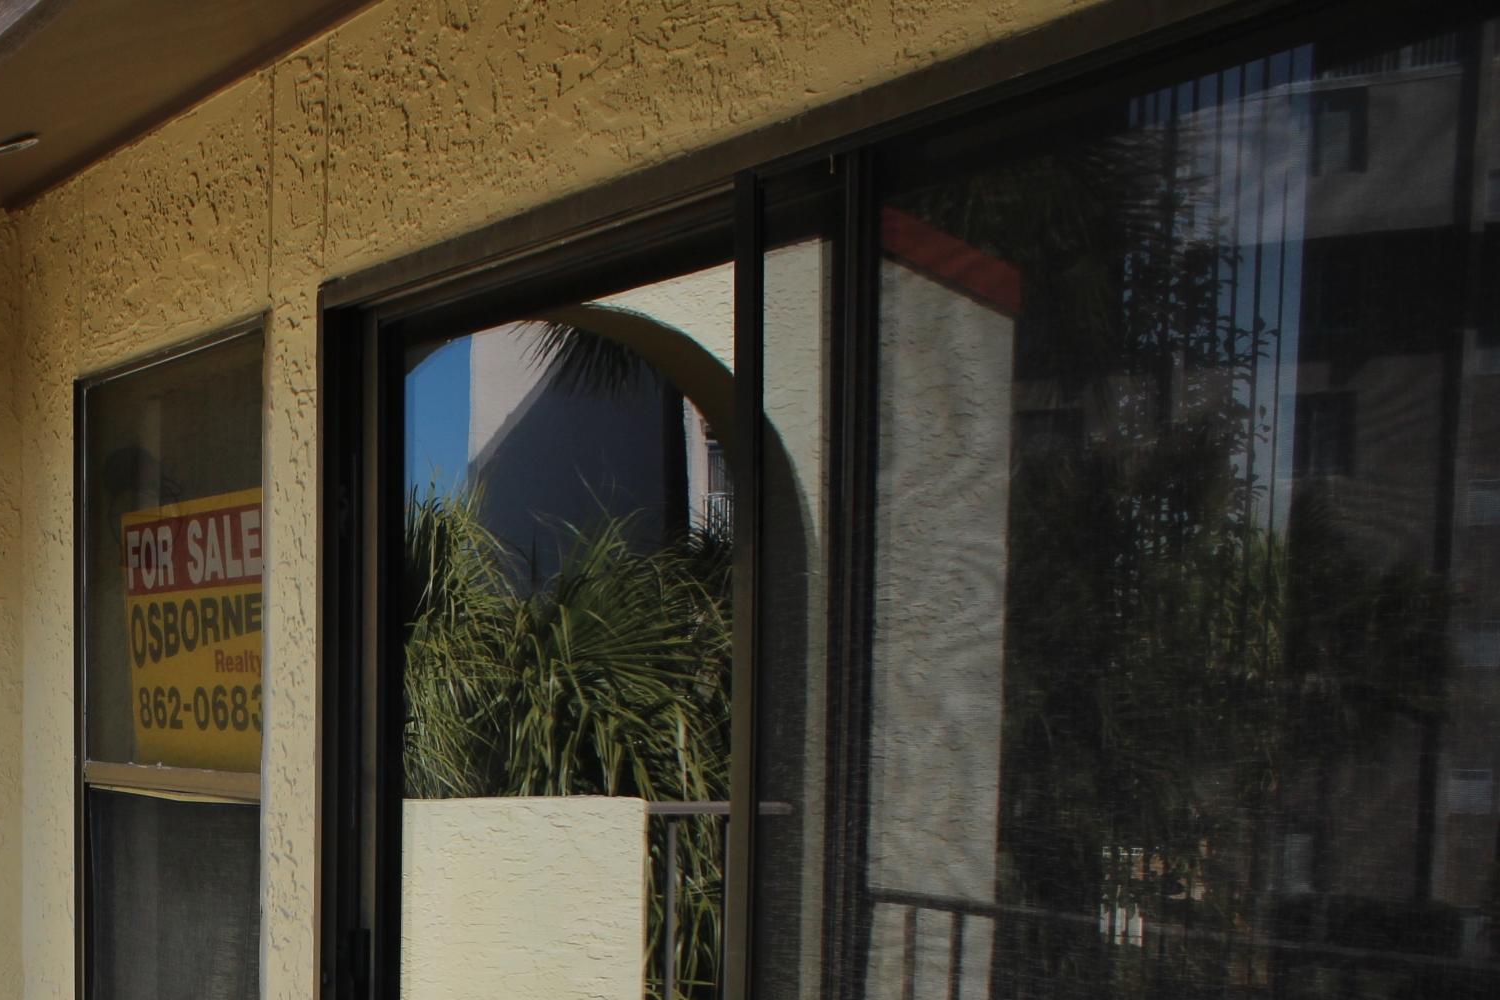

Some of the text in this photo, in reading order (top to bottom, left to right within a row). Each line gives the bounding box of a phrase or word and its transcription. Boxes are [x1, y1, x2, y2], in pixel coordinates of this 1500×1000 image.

[128, 510, 262, 589] FOR SALE
[131, 592, 262, 668] OSBORNE
[215, 649, 262, 676] Realty
